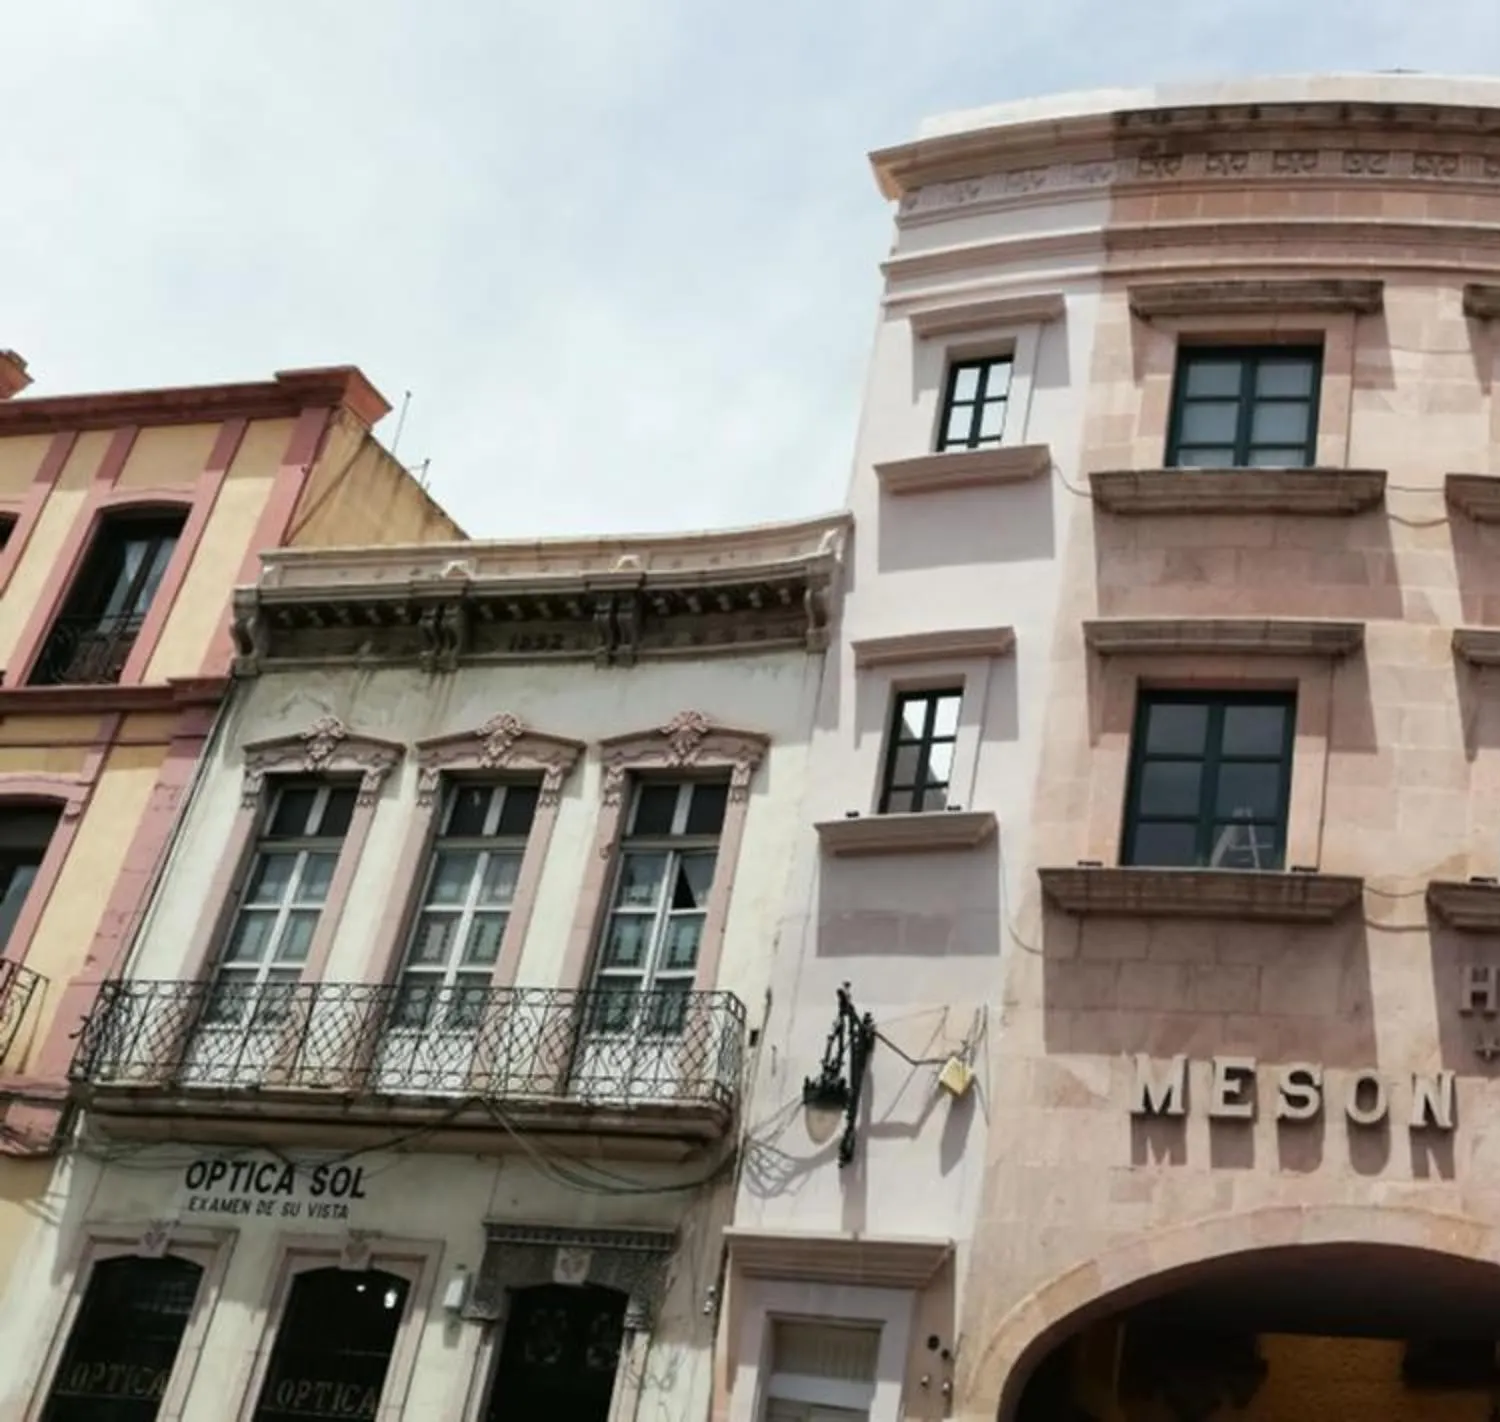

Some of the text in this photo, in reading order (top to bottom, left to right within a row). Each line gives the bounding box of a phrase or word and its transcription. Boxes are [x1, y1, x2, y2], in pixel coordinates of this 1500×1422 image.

[1129, 1053, 1458, 1128] MESON
[185, 1160, 366, 1199] OPTICA SOL
[188, 1195, 349, 1219] EXAMEN DE SU VISTA
[70, 1361, 170, 1397] OPTICA
[276, 1378, 378, 1414] OPTICA
